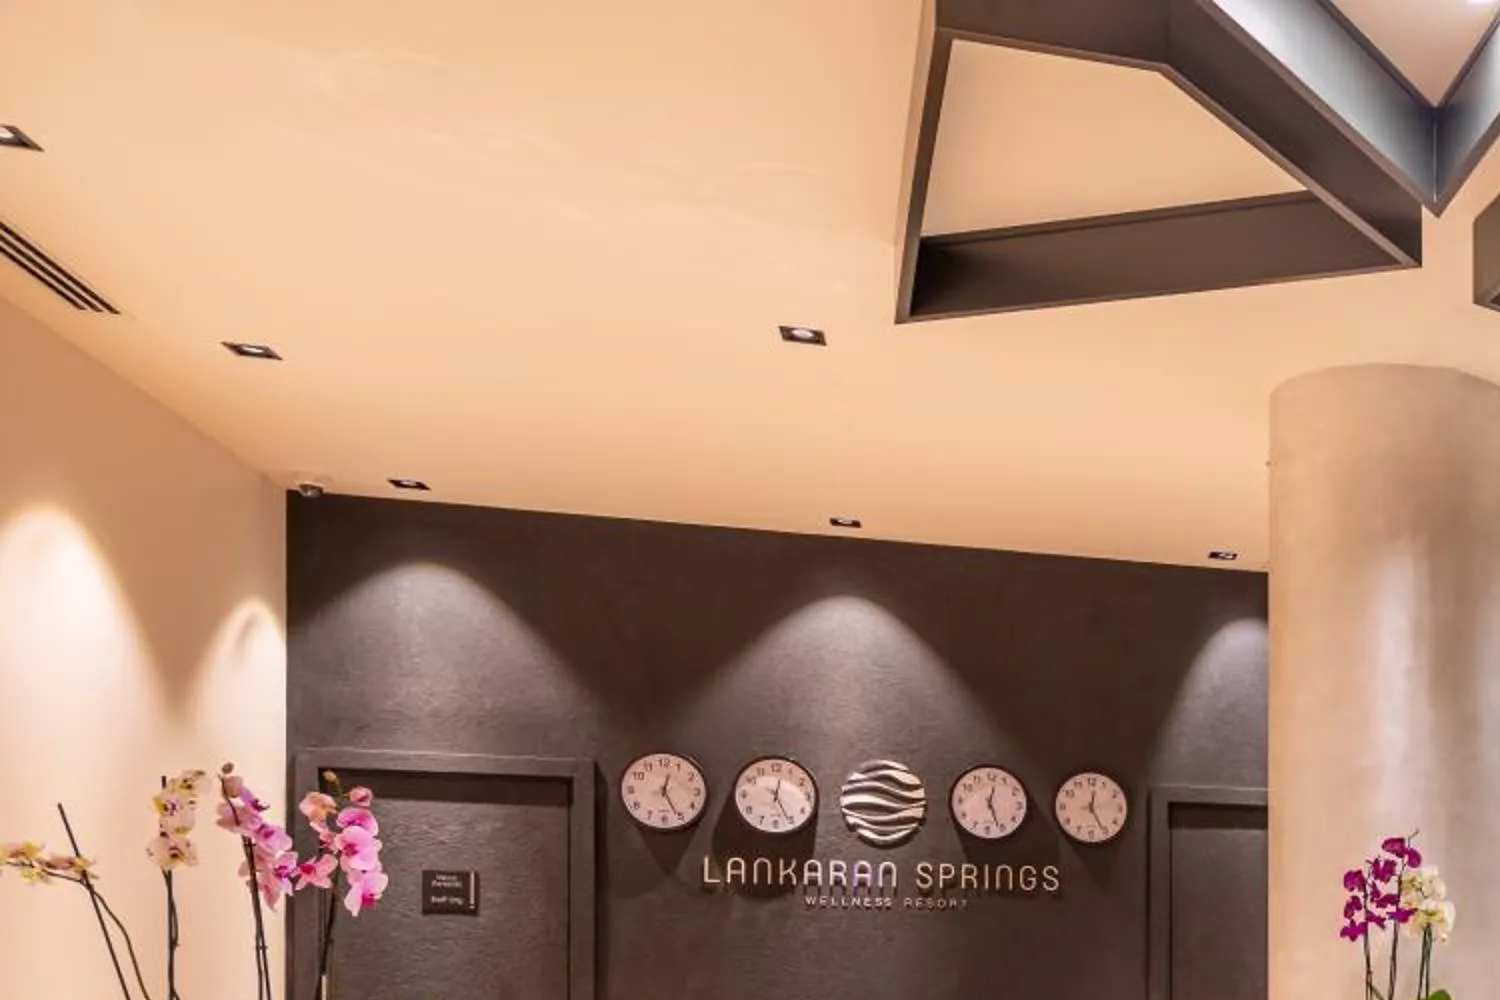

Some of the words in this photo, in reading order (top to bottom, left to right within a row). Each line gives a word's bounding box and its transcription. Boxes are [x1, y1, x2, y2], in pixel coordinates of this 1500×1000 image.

[703, 855, 897, 888] LANKARAN
[915, 861, 1060, 891] SPRINGS
[805, 895, 893, 908] WELLNESS
[903, 897, 968, 909] RESORT
